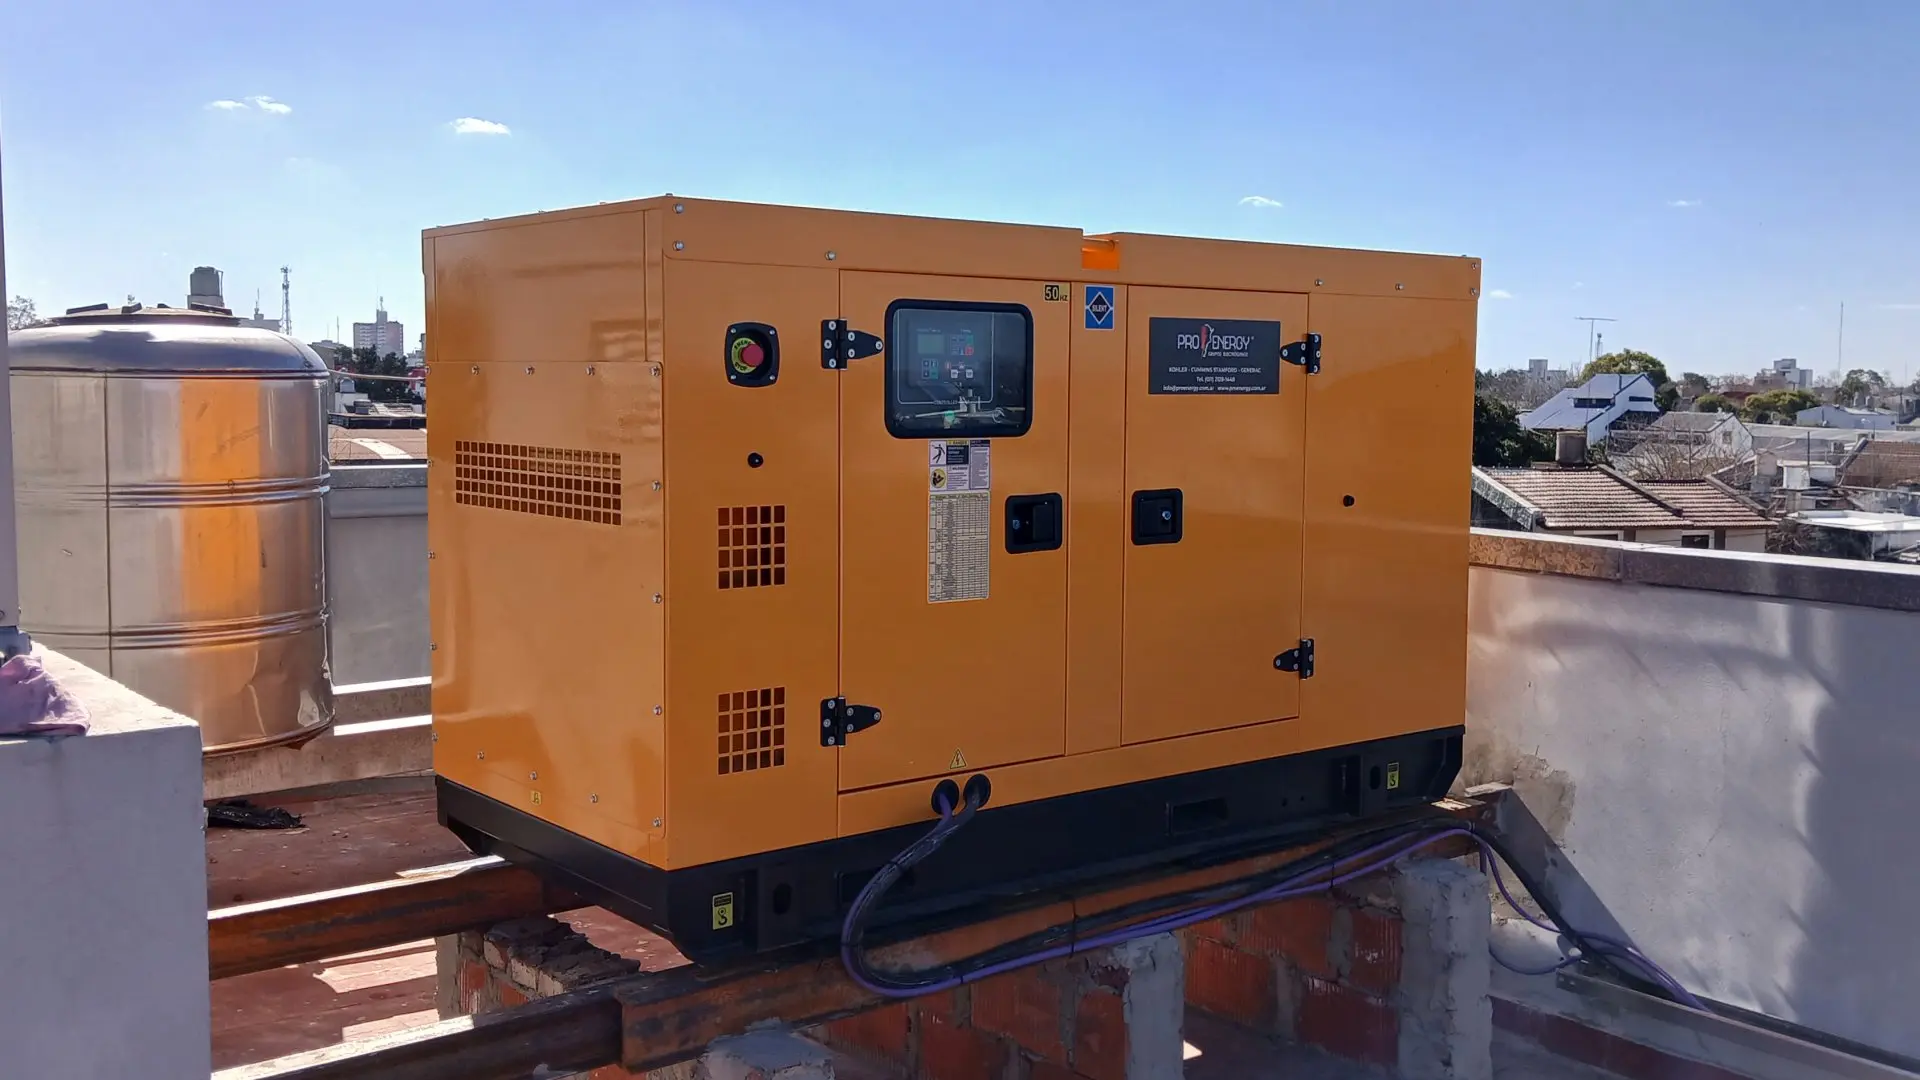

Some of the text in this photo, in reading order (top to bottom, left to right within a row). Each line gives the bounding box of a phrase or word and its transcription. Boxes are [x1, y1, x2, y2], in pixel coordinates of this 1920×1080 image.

[1045, 286, 1059, 300] 50
[1092, 304, 1107, 312] SILENT
[1177, 334, 1250, 350] PRO ENERGY
[735, 361, 748, 371] STOP
